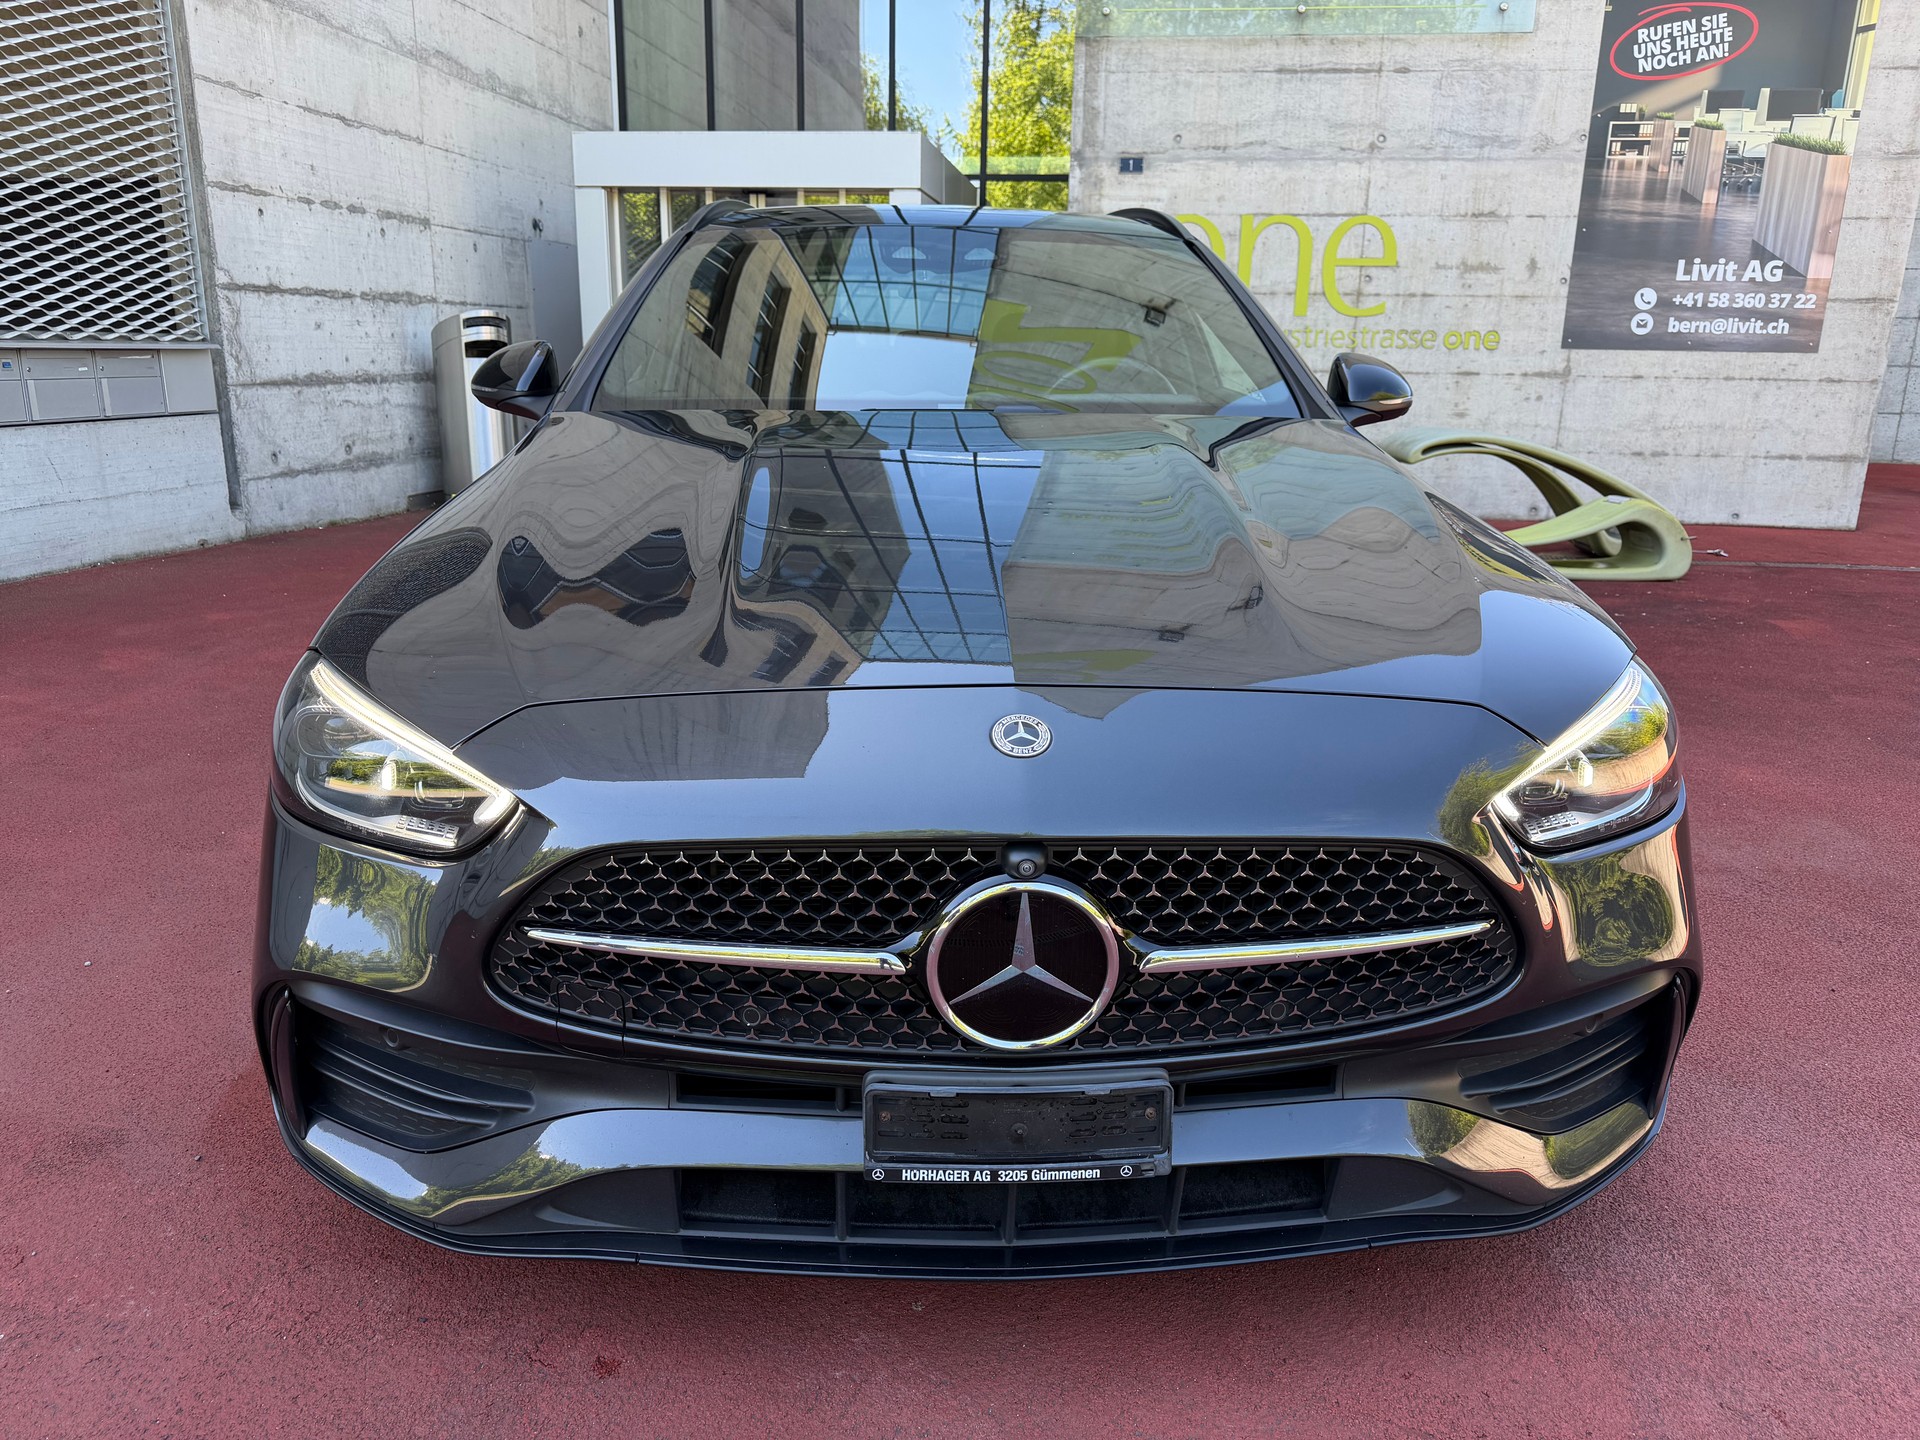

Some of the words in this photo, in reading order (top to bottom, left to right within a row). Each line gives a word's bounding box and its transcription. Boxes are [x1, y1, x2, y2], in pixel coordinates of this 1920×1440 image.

[1637, 18, 1697, 44] RUFEN
[1701, 12, 1728, 31] SIE
[1633, 38, 1672, 59] UNS
[1676, 26, 1733, 51] HEUTE
[1638, 49, 1691, 73] NOCH
[1695, 42, 1730, 63] AN!
[1129, 159, 1134, 171] 1
[1675, 257, 1738, 282] Livit
[1741, 259, 1784, 282] AG
[1672, 292, 1704, 308] +41
[1707, 292, 1730, 308] 58
[1732, 292, 1766, 309] 360
[1768, 293, 1792, 309] 37
[1793, 293, 1817, 309] 22
[1284, 325, 1437, 349] striestrasse
[1443, 329, 1501, 350] one
[1667, 316, 1790, 335] bern@livit.ch
[973, 1170, 991, 1182] AG
[998, 1170, 1028, 1182] 3205
[1031, 1168, 1101, 1181] Gümmenen
